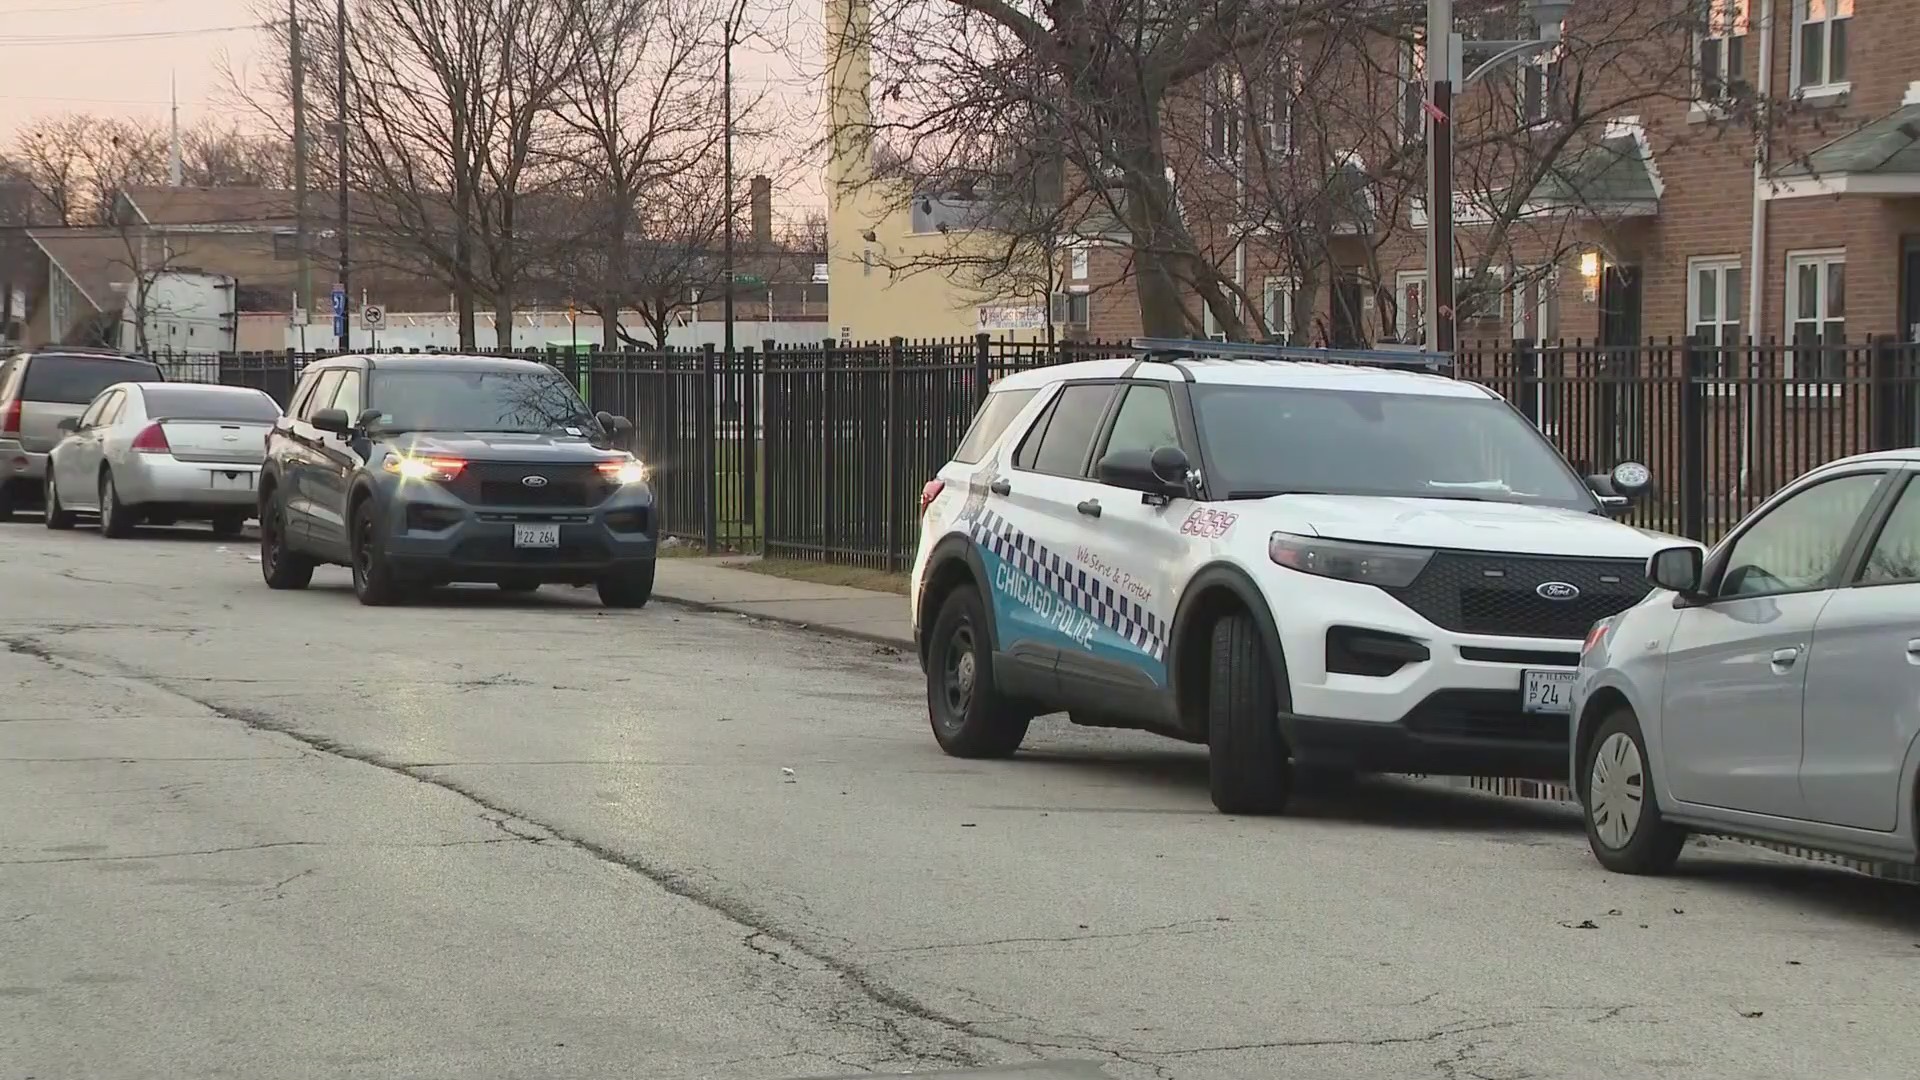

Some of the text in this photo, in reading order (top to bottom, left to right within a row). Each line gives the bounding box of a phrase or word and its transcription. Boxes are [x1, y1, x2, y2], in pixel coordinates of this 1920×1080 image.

[523, 531, 555, 543] 22 264
[1180, 507, 1239, 539] 8969
[1076, 545, 1152, 601] We Serve & Protect
[996, 563, 1099, 650] CHICAGO POLICE
[1541, 684, 1559, 705] 24
